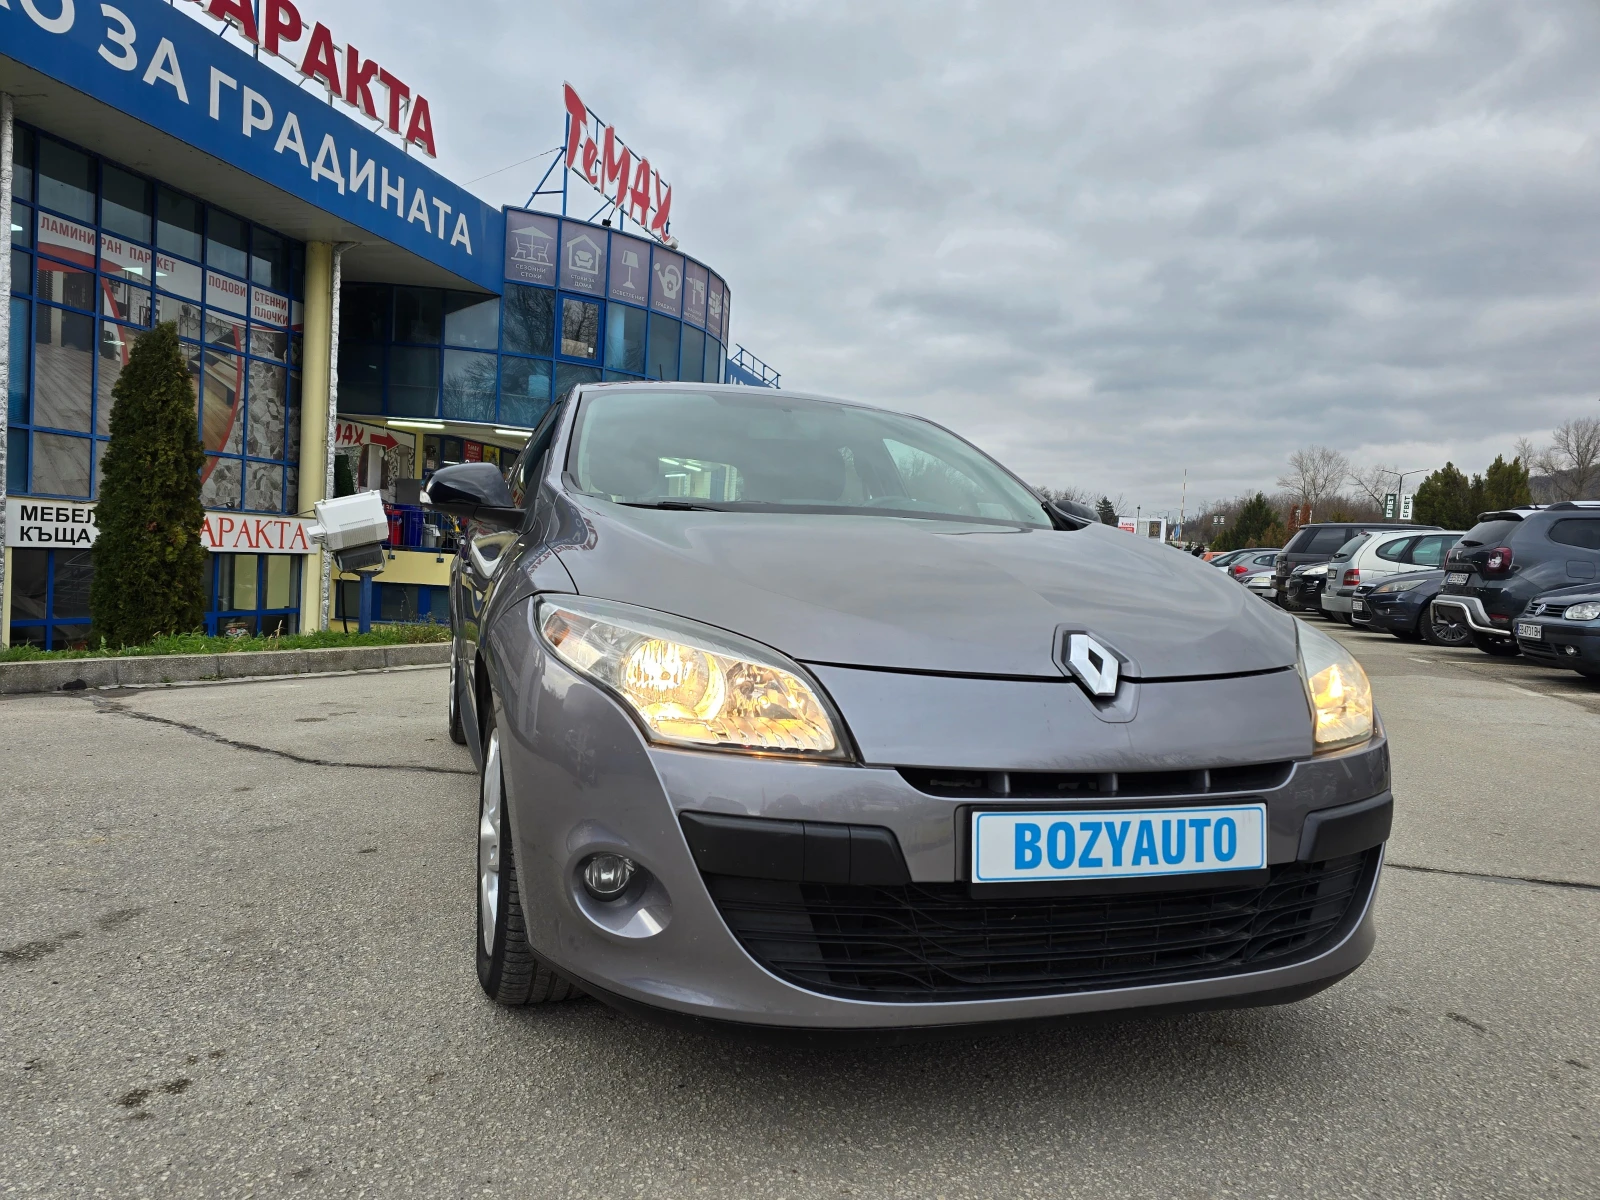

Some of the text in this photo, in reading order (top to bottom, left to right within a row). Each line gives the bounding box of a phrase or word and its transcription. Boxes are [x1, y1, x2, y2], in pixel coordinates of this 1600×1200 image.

[98, 3, 473, 256] ЗА ГРАДИНАТА
[41, 216, 176, 273] ЛАМИНИРАН ПАРКЕТ
[515, 263, 546, 273] СЕЗОННИ
[520, 271, 542, 279] СТОКИ
[208, 274, 247, 298] ПОДОВИ
[574, 281, 593, 289] ДОМА
[254, 290, 287, 310] СТЕННИ
[254, 304, 289, 325] ПЛОЧКИ
[1402, 496, 1410, 518] EFBET
[19, 525, 91, 545] КЪЩА
[1014, 816, 1238, 870] BOZYAUTO
